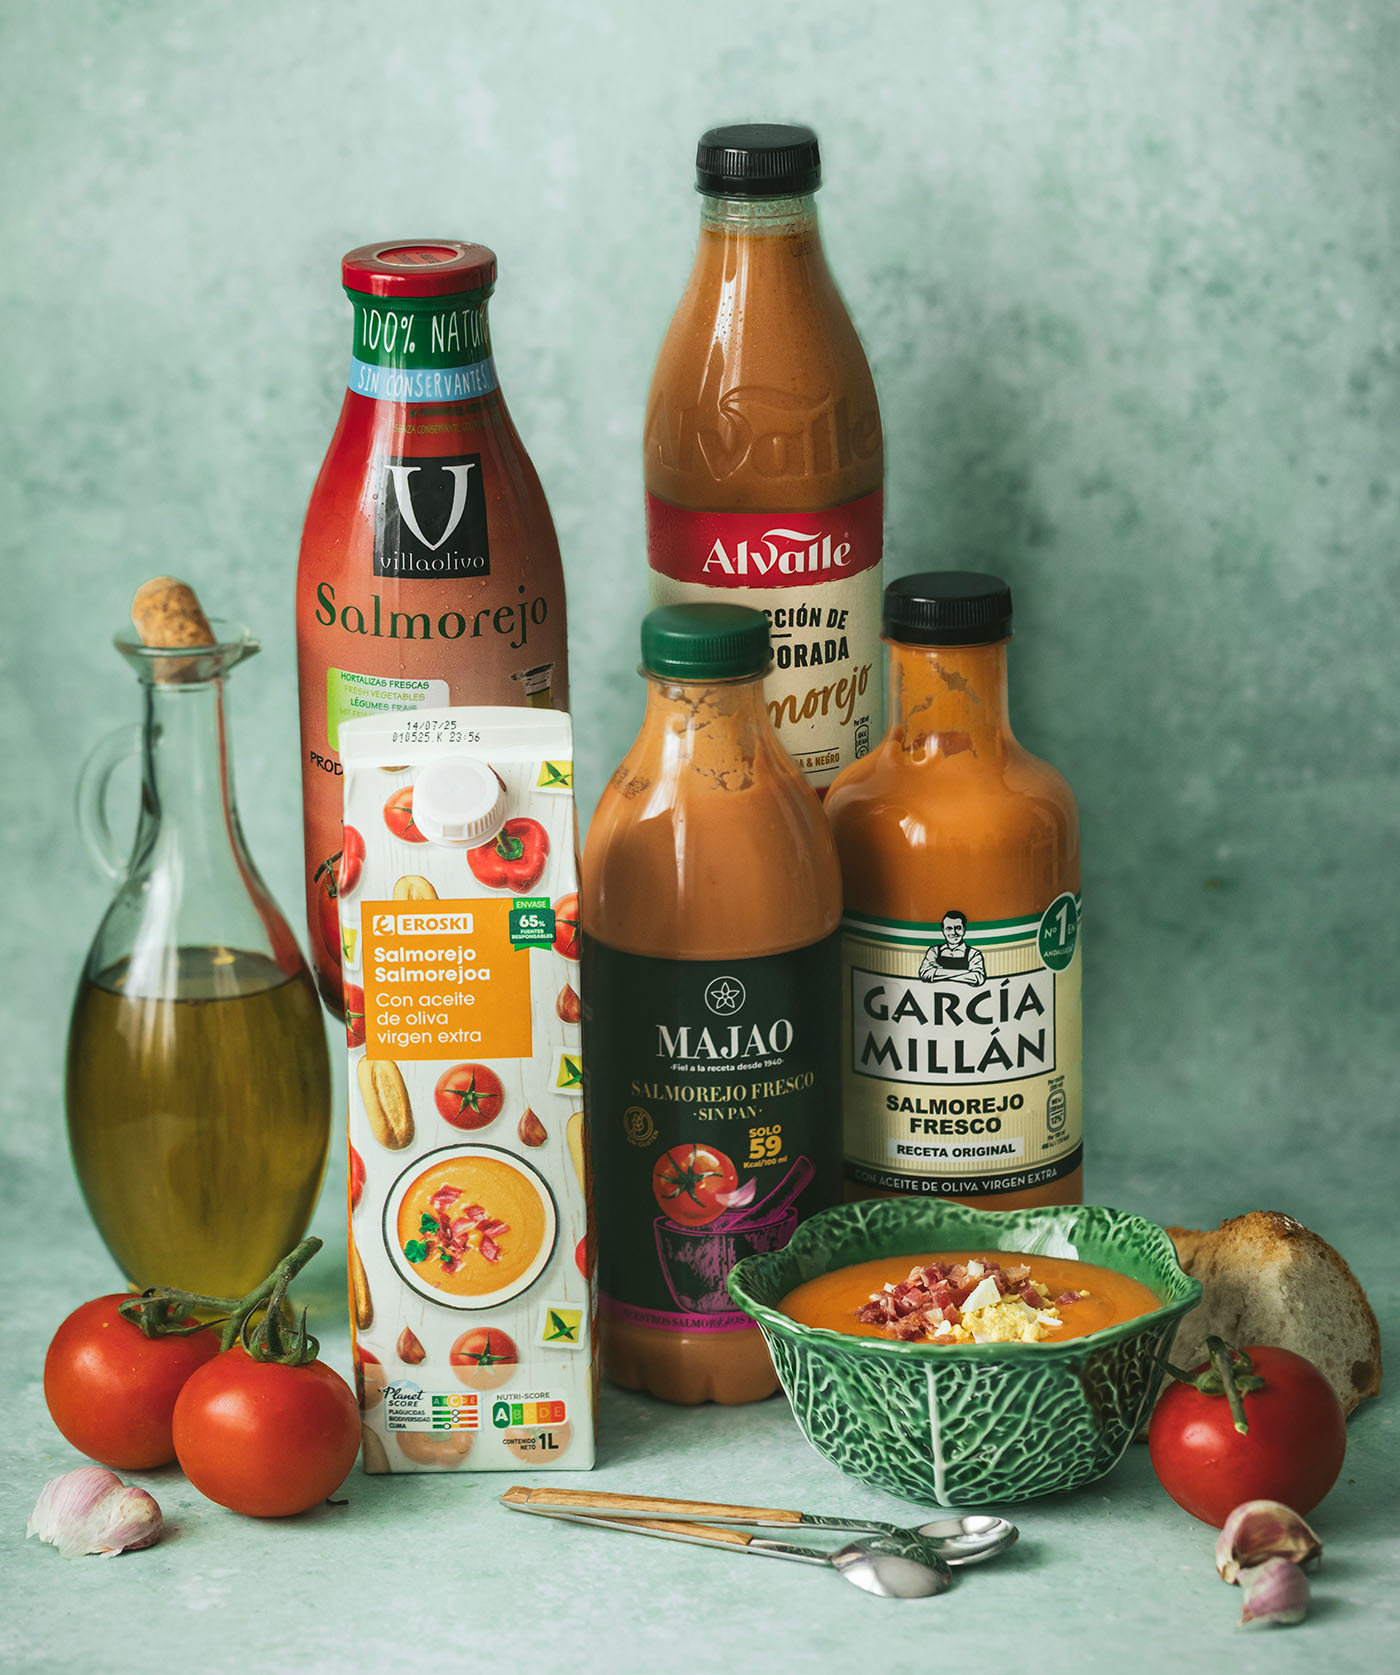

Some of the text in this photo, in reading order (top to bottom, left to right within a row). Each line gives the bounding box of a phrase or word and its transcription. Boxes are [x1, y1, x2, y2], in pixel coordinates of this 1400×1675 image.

[362, 308, 416, 354] 100%
[357, 366, 380, 393] SIN
[702, 528, 852, 576] Alvalle
[380, 551, 485, 572] villaolivo
[315, 581, 549, 649] Salmorejo
[826, 608, 849, 630] DE
[340, 672, 430, 690] HORTALIZAS FRESCAS
[344, 685, 426, 701] FRESH VEGETABLES
[350, 696, 390, 711] LÉGUMES
[407, 720, 457, 731] 14/07/25
[449, 731, 480, 743] 23:56
[516, 900, 547, 909] ENVASE
[402, 917, 468, 931] EROSKI
[519, 914, 546, 928] 65%
[1056, 902, 1067, 946] 1
[374, 946, 476, 964] Salmorejo
[374, 966, 491, 985] Salmorejoa
[376, 992, 475, 1008] Con aceite
[863, 978, 1046, 1026] GARCÍA
[376, 1011, 449, 1026] de oliva
[377, 1028, 482, 1047] virgen extra
[655, 1019, 794, 1060] MAJAO
[860, 1027, 1046, 1074] MILLÁN
[697, 1064, 706, 1072] la
[737, 1061, 763, 1071] desde
[631, 1071, 815, 1103] SALMOREJO FRESCO
[886, 1093, 1024, 1115] SALMOREJO
[749, 1124, 782, 1138] SOLO
[909, 1117, 1002, 1135] FRESCO
[748, 1135, 783, 1160] 59
[897, 1144, 1016, 1158] RECETA ORIGINAL
[854, 1168, 1058, 1192] CON ACEITE DE OLIVA VIRGEN EXTRA
[380, 1386, 426, 1401] Planet
[496, 1391, 551, 1401] NUTRI-SCORE
[388, 1400, 419, 1408] SCORE
[538, 1433, 559, 1450] 1L
